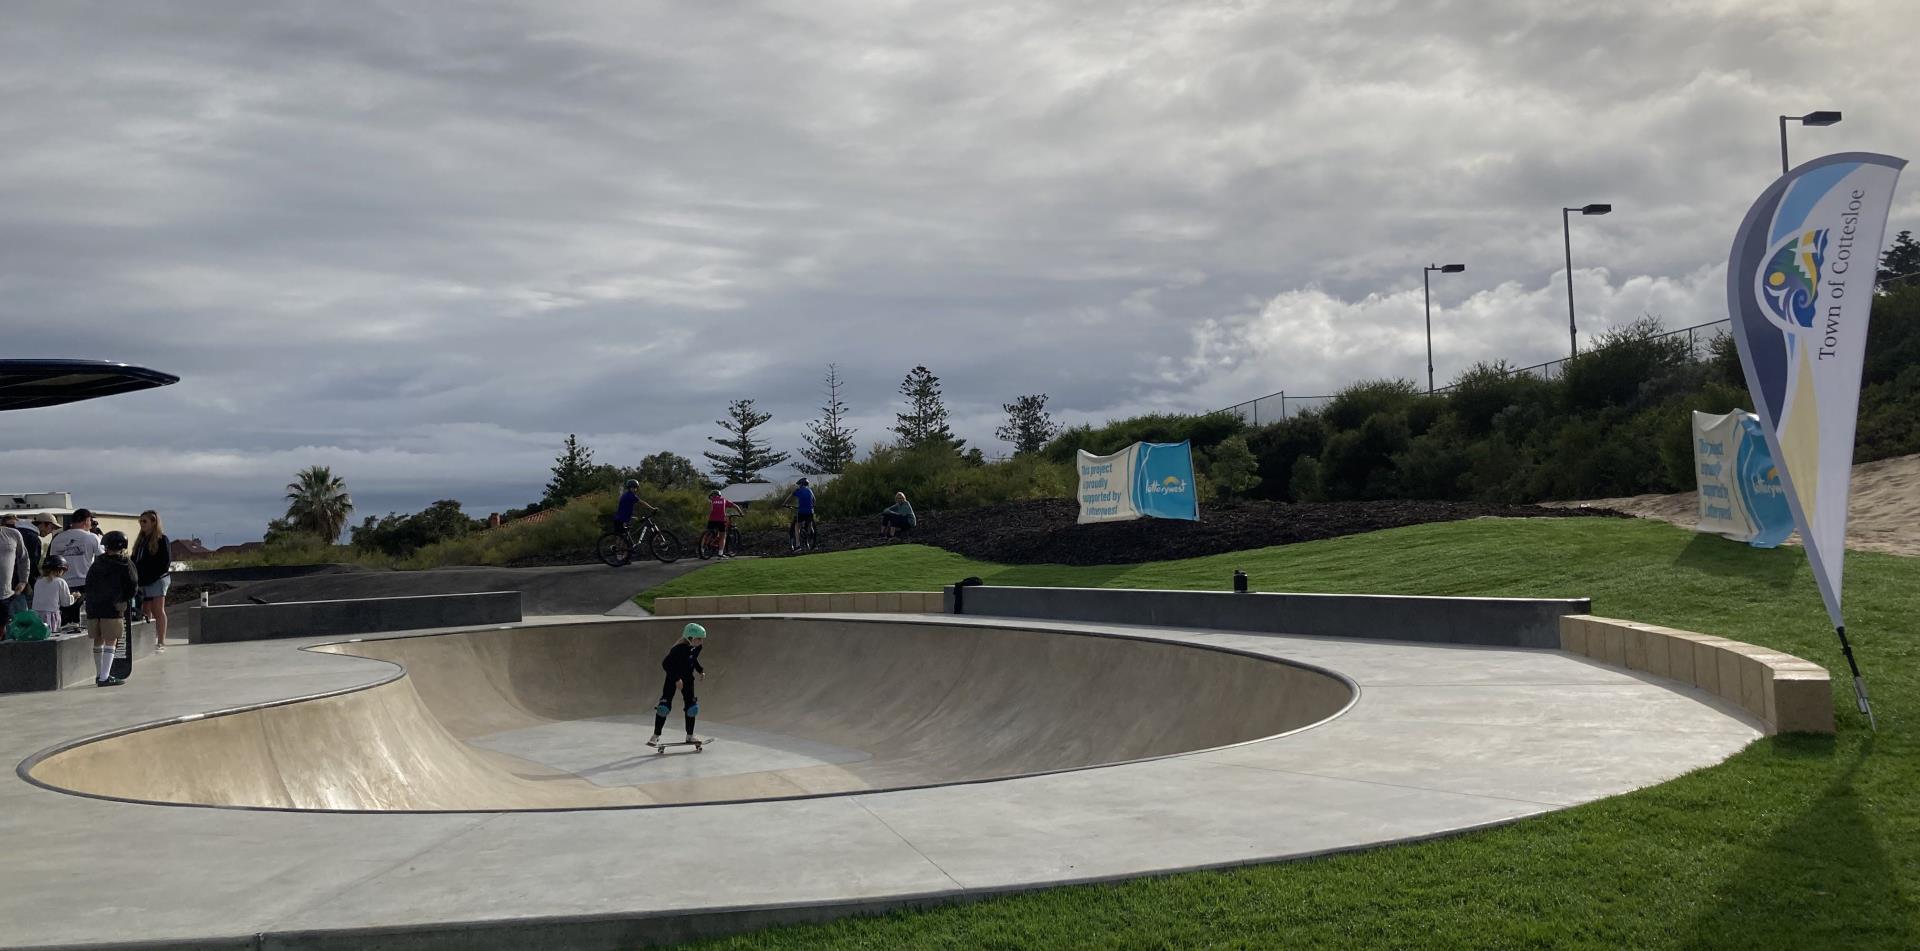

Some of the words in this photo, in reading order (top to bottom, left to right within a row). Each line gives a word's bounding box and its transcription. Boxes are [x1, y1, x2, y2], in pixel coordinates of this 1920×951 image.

[1832, 190, 1865, 274] Cottesloe
[1828, 280, 1845, 299] of
[1819, 305, 1841, 360] Town
[1091, 463, 1112, 477] project
[1113, 490, 1122, 503] by
